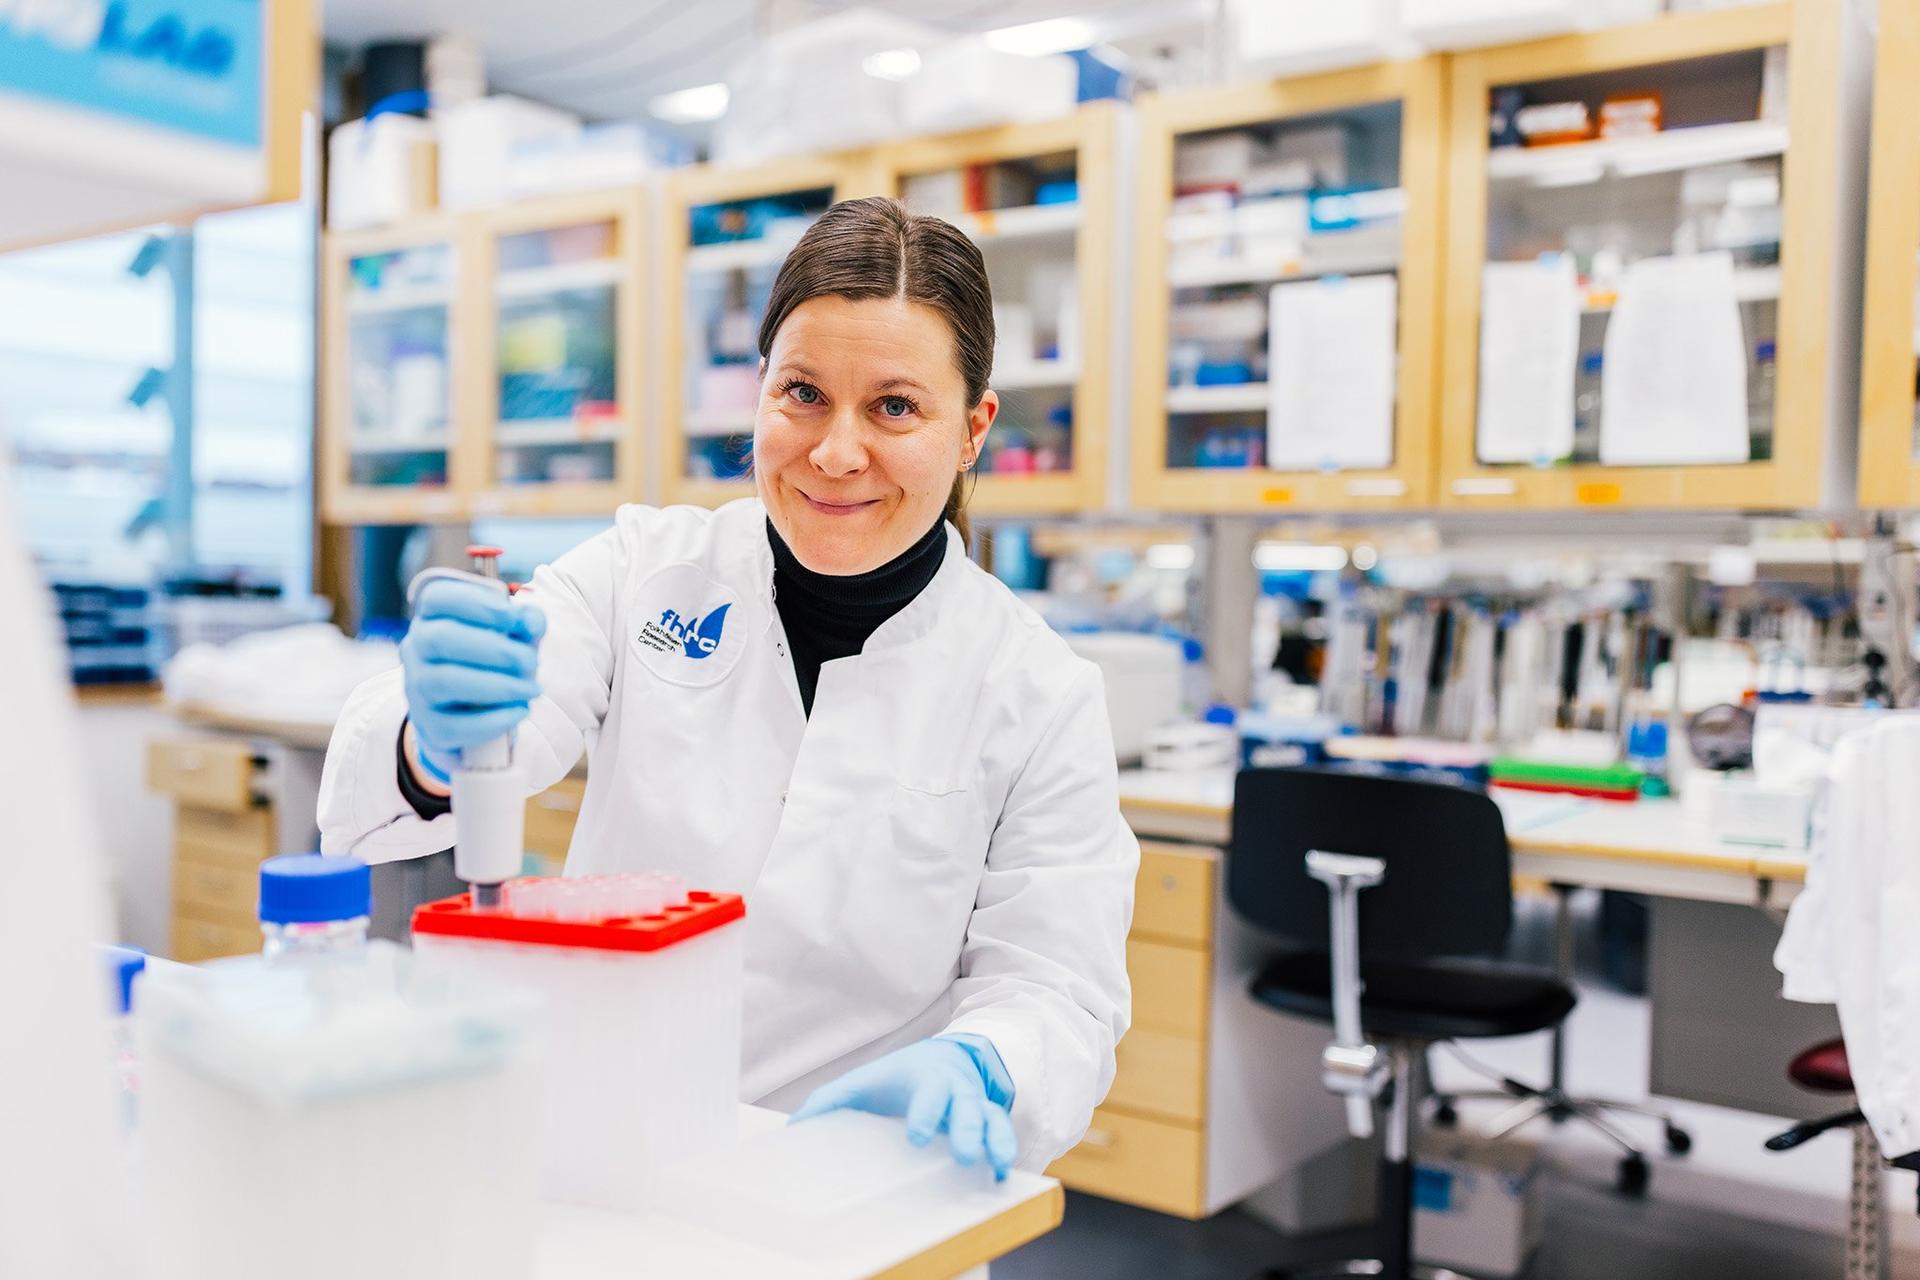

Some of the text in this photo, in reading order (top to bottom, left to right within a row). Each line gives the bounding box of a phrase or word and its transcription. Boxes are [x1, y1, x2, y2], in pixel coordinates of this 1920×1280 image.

[641, 628, 676, 652] Research
[660, 608, 717, 653] fhrc
[638, 635, 664, 653] Center
